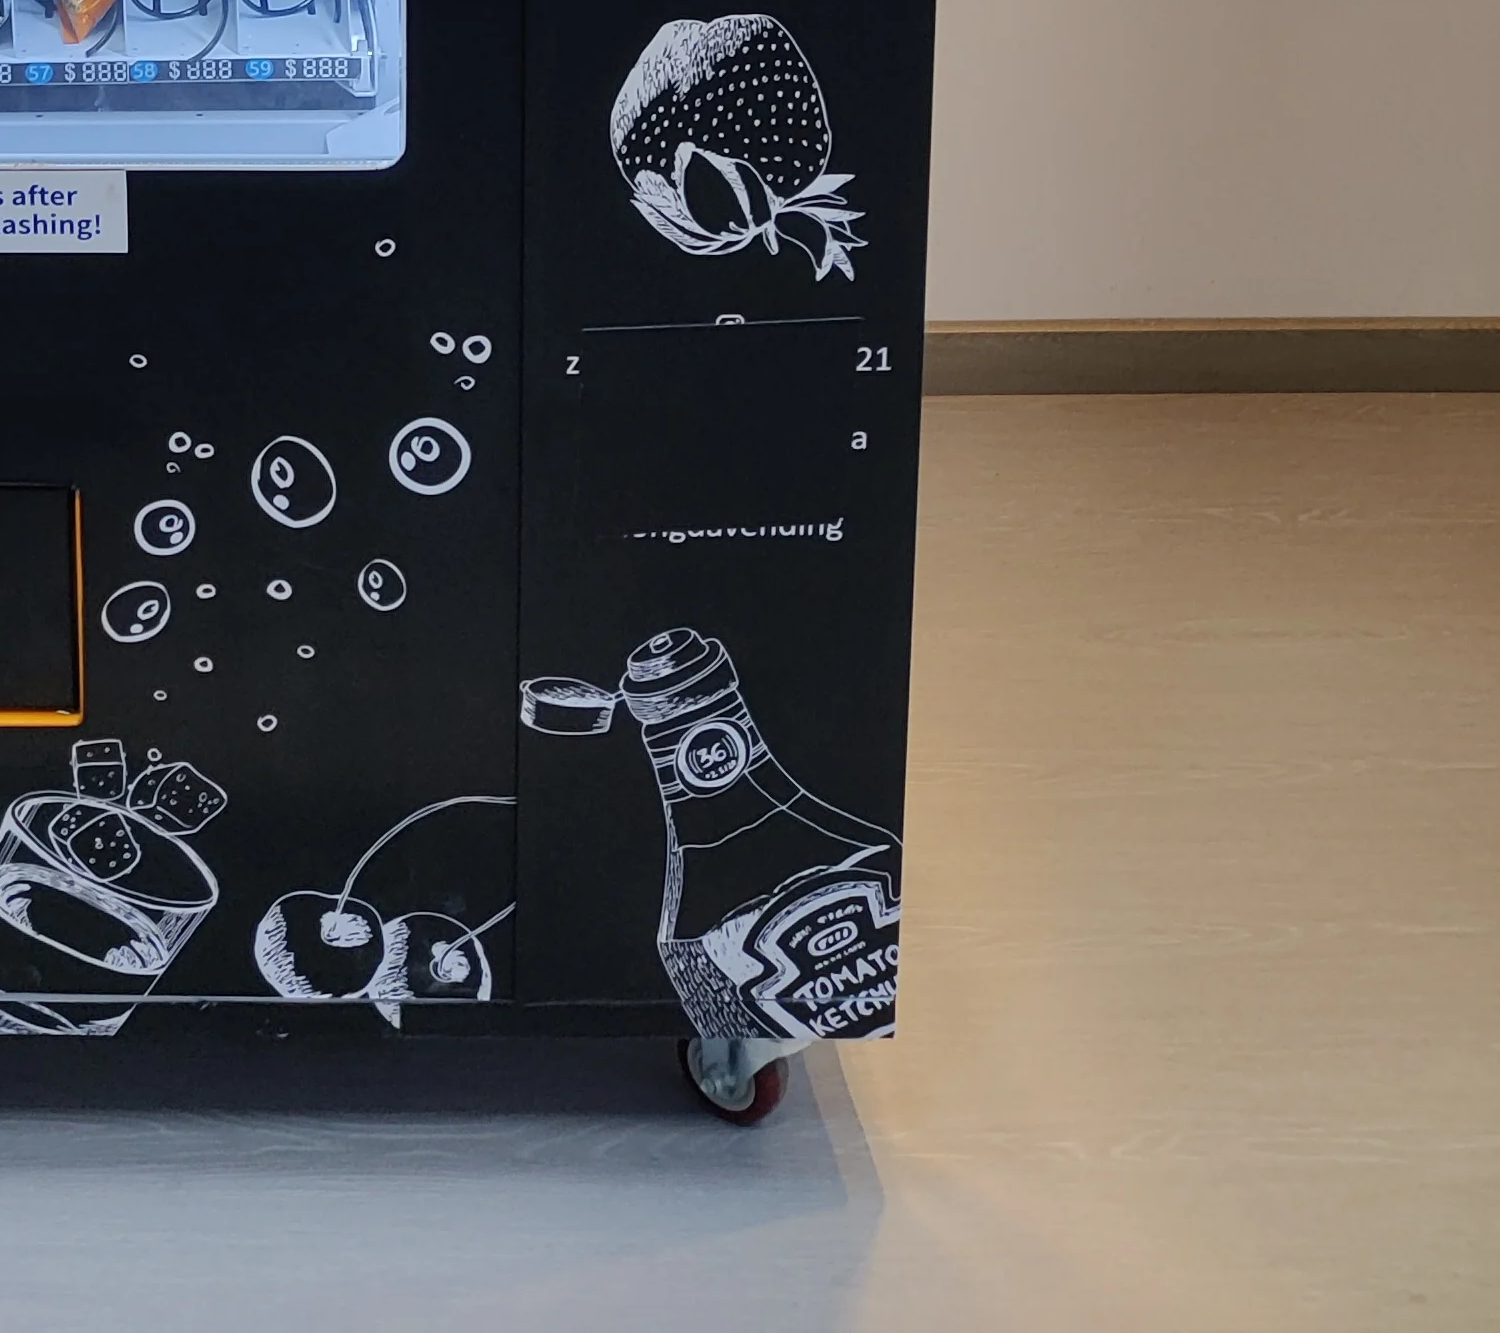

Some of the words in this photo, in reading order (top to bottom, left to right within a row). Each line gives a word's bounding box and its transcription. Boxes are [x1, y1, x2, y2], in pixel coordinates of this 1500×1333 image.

[12, 184, 78, 206] after
[565, 355, 580, 375] z
[855, 346, 893, 372] 21
[850, 431, 868, 450] a
[793, 944, 898, 1012] TOMATO
